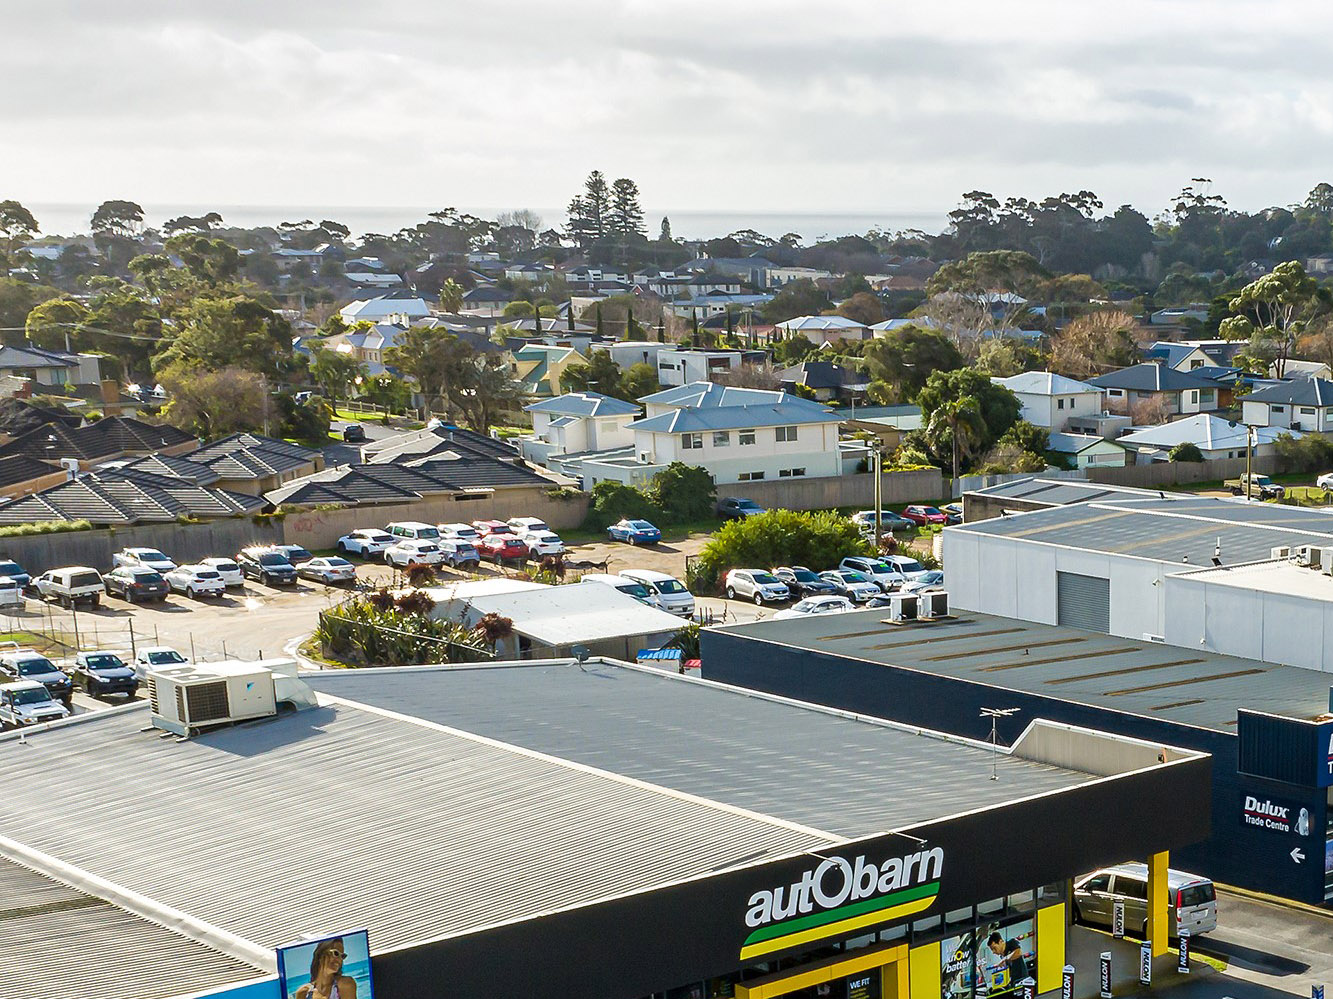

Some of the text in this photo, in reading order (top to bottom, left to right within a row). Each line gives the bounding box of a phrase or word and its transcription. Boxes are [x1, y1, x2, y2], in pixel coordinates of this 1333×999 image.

[1244, 795, 1289, 819] Dulux
[1244, 813, 1290, 832] Trade Centre
[1115, 906, 1123, 934] NULON
[1180, 937, 1188, 967] NULON
[849, 977, 871, 990] WE FIT
